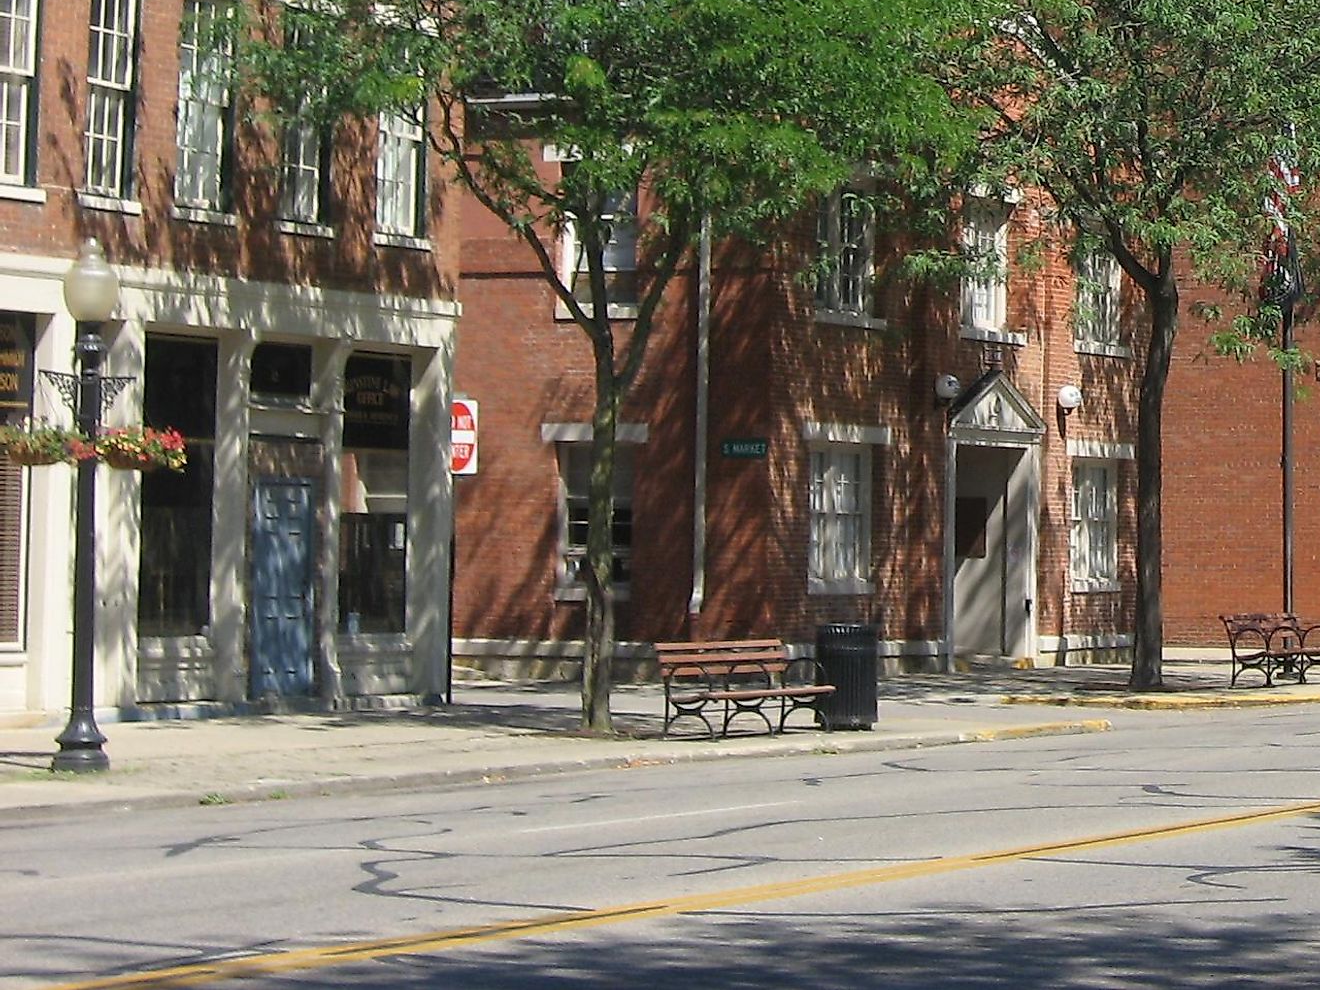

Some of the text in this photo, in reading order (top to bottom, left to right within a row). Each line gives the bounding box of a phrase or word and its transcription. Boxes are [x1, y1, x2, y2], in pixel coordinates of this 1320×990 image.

[457, 415, 471, 429] NOT
[451, 444, 470, 459] TER
[732, 443, 766, 454] MARKET
